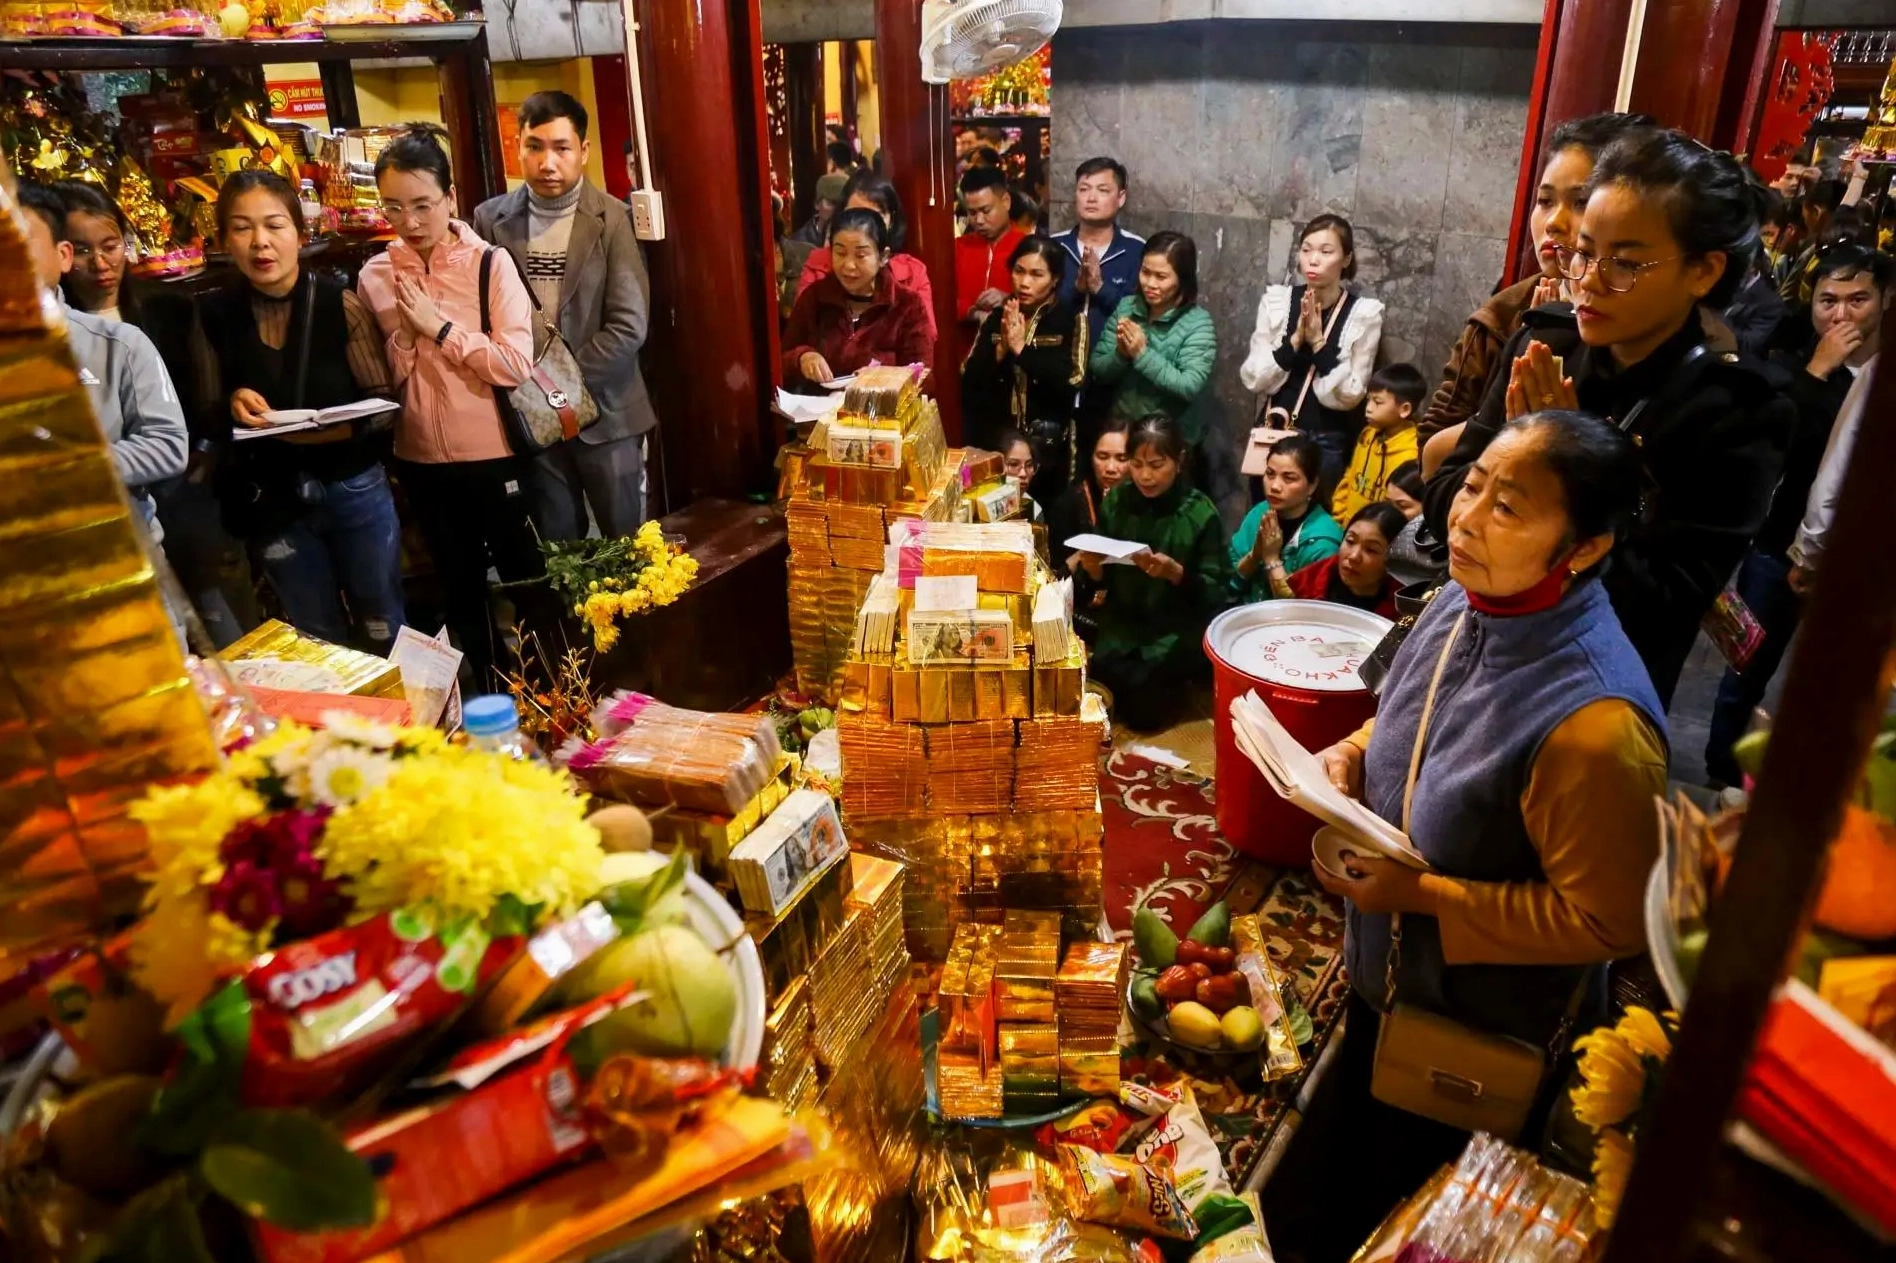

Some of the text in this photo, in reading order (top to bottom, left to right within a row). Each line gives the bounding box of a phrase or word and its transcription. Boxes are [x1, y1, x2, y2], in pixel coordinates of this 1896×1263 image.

[293, 102, 326, 112] NO SMOKIN
[1285, 668, 1338, 680] KHO
[267, 950, 357, 1010] COSY
